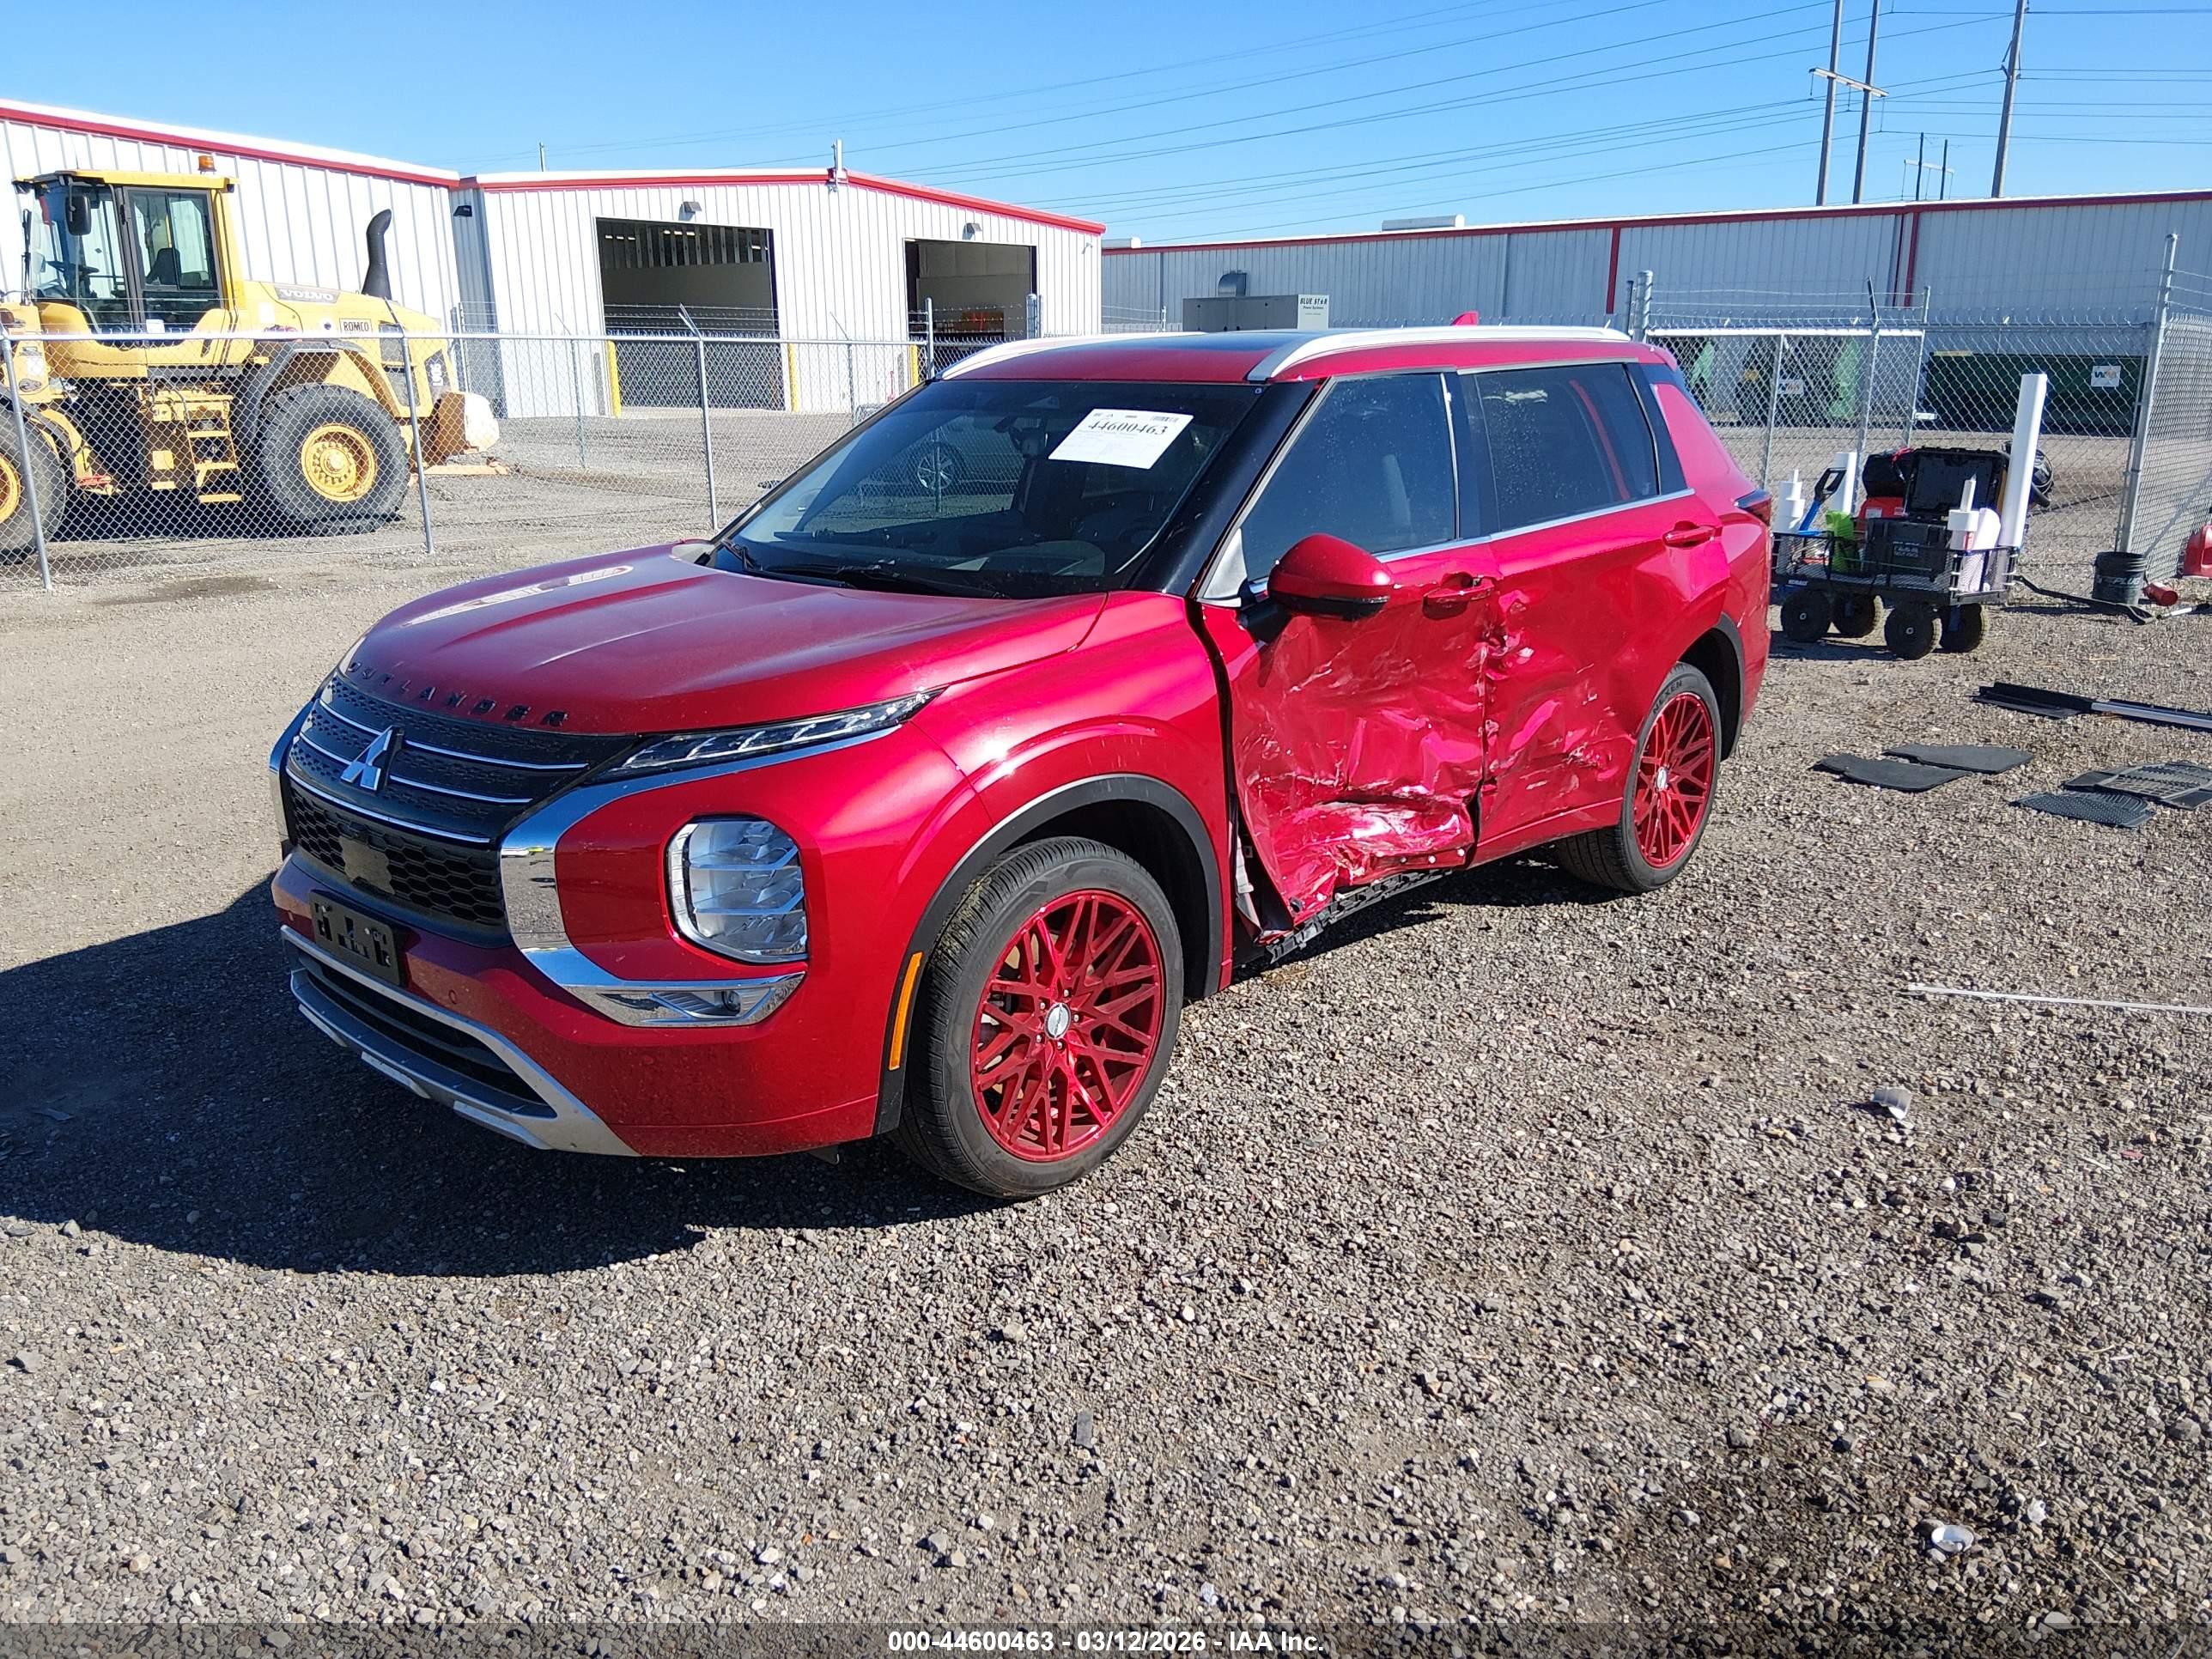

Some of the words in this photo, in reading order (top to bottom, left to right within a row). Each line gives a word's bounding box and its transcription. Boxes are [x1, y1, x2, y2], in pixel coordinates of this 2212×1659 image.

[279, 289, 334, 301] VOLVO
[343, 321, 369, 332] ROMCO
[1088, 420, 1169, 435] 44600463
[348, 662, 568, 726] OUTLANDER
[1652, 679, 1683, 714] NEXEN
